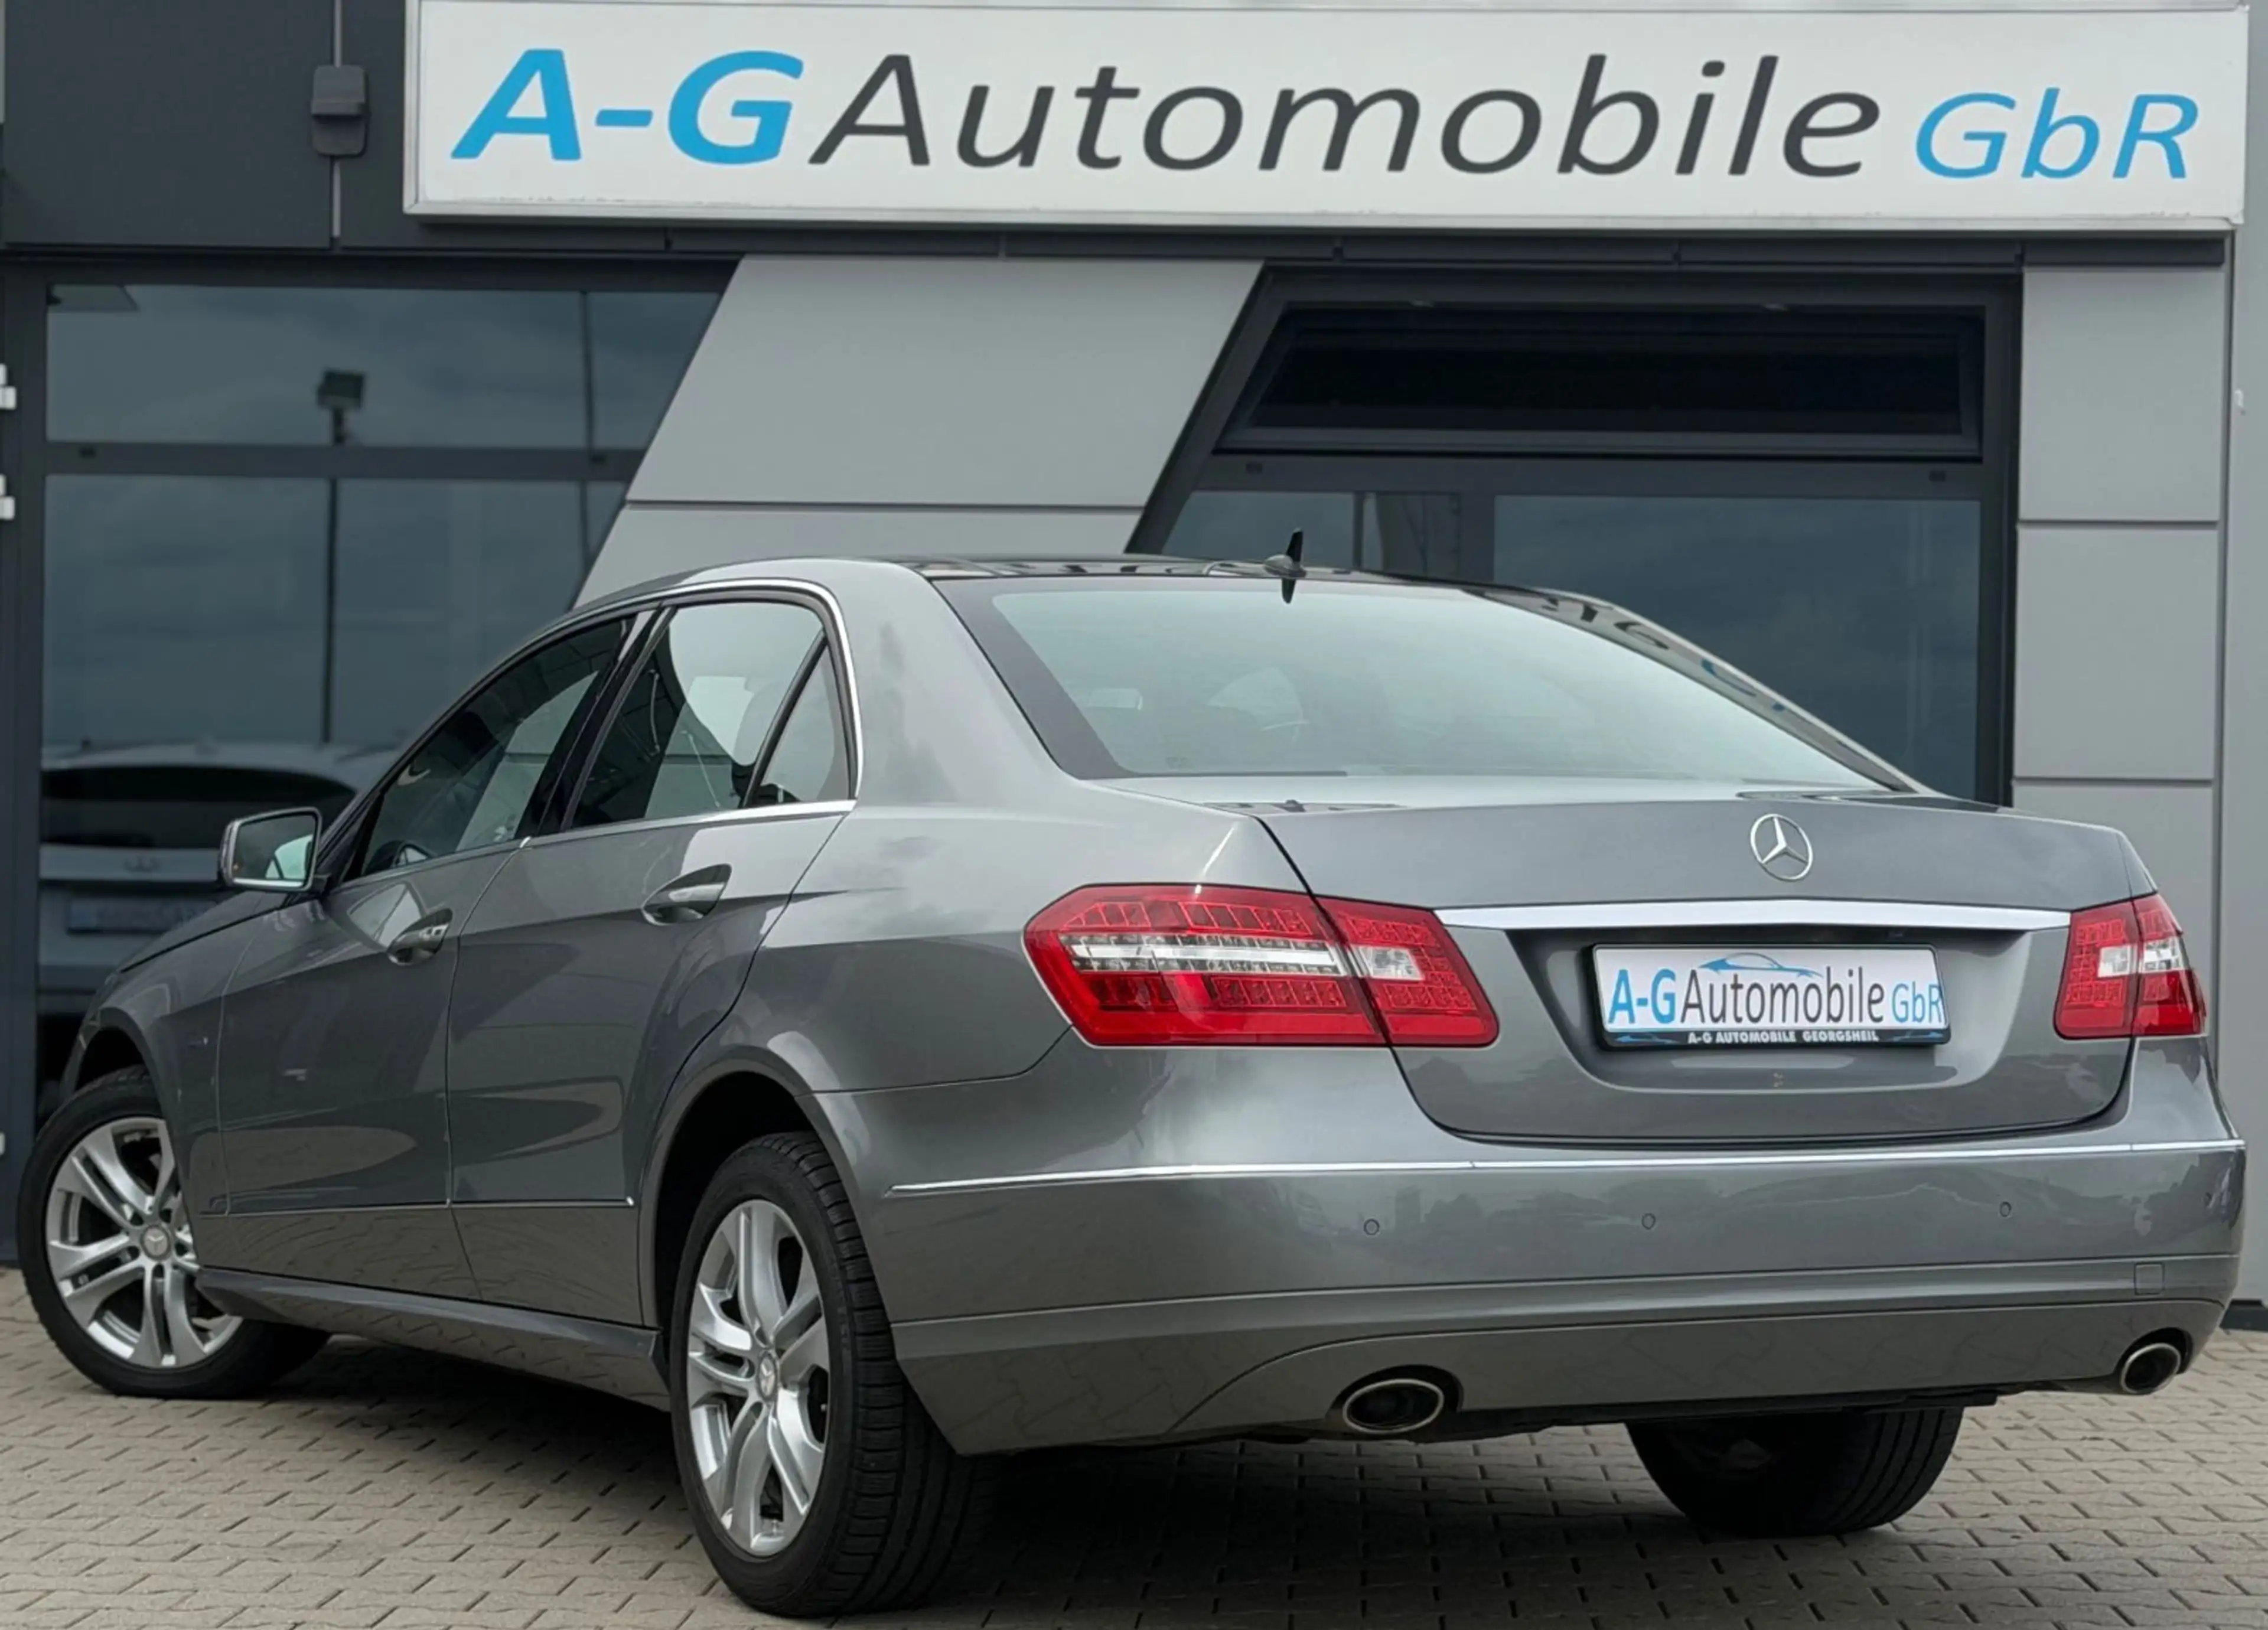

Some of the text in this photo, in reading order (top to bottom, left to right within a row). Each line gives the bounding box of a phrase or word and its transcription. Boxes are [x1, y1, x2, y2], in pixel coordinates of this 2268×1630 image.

[1914, 86, 2199, 180] GbR
[1892, 980, 1943, 1023] GbR
[1687, 1030, 1880, 1044] A-G AUTOMOBILE GEORGSHEIL
